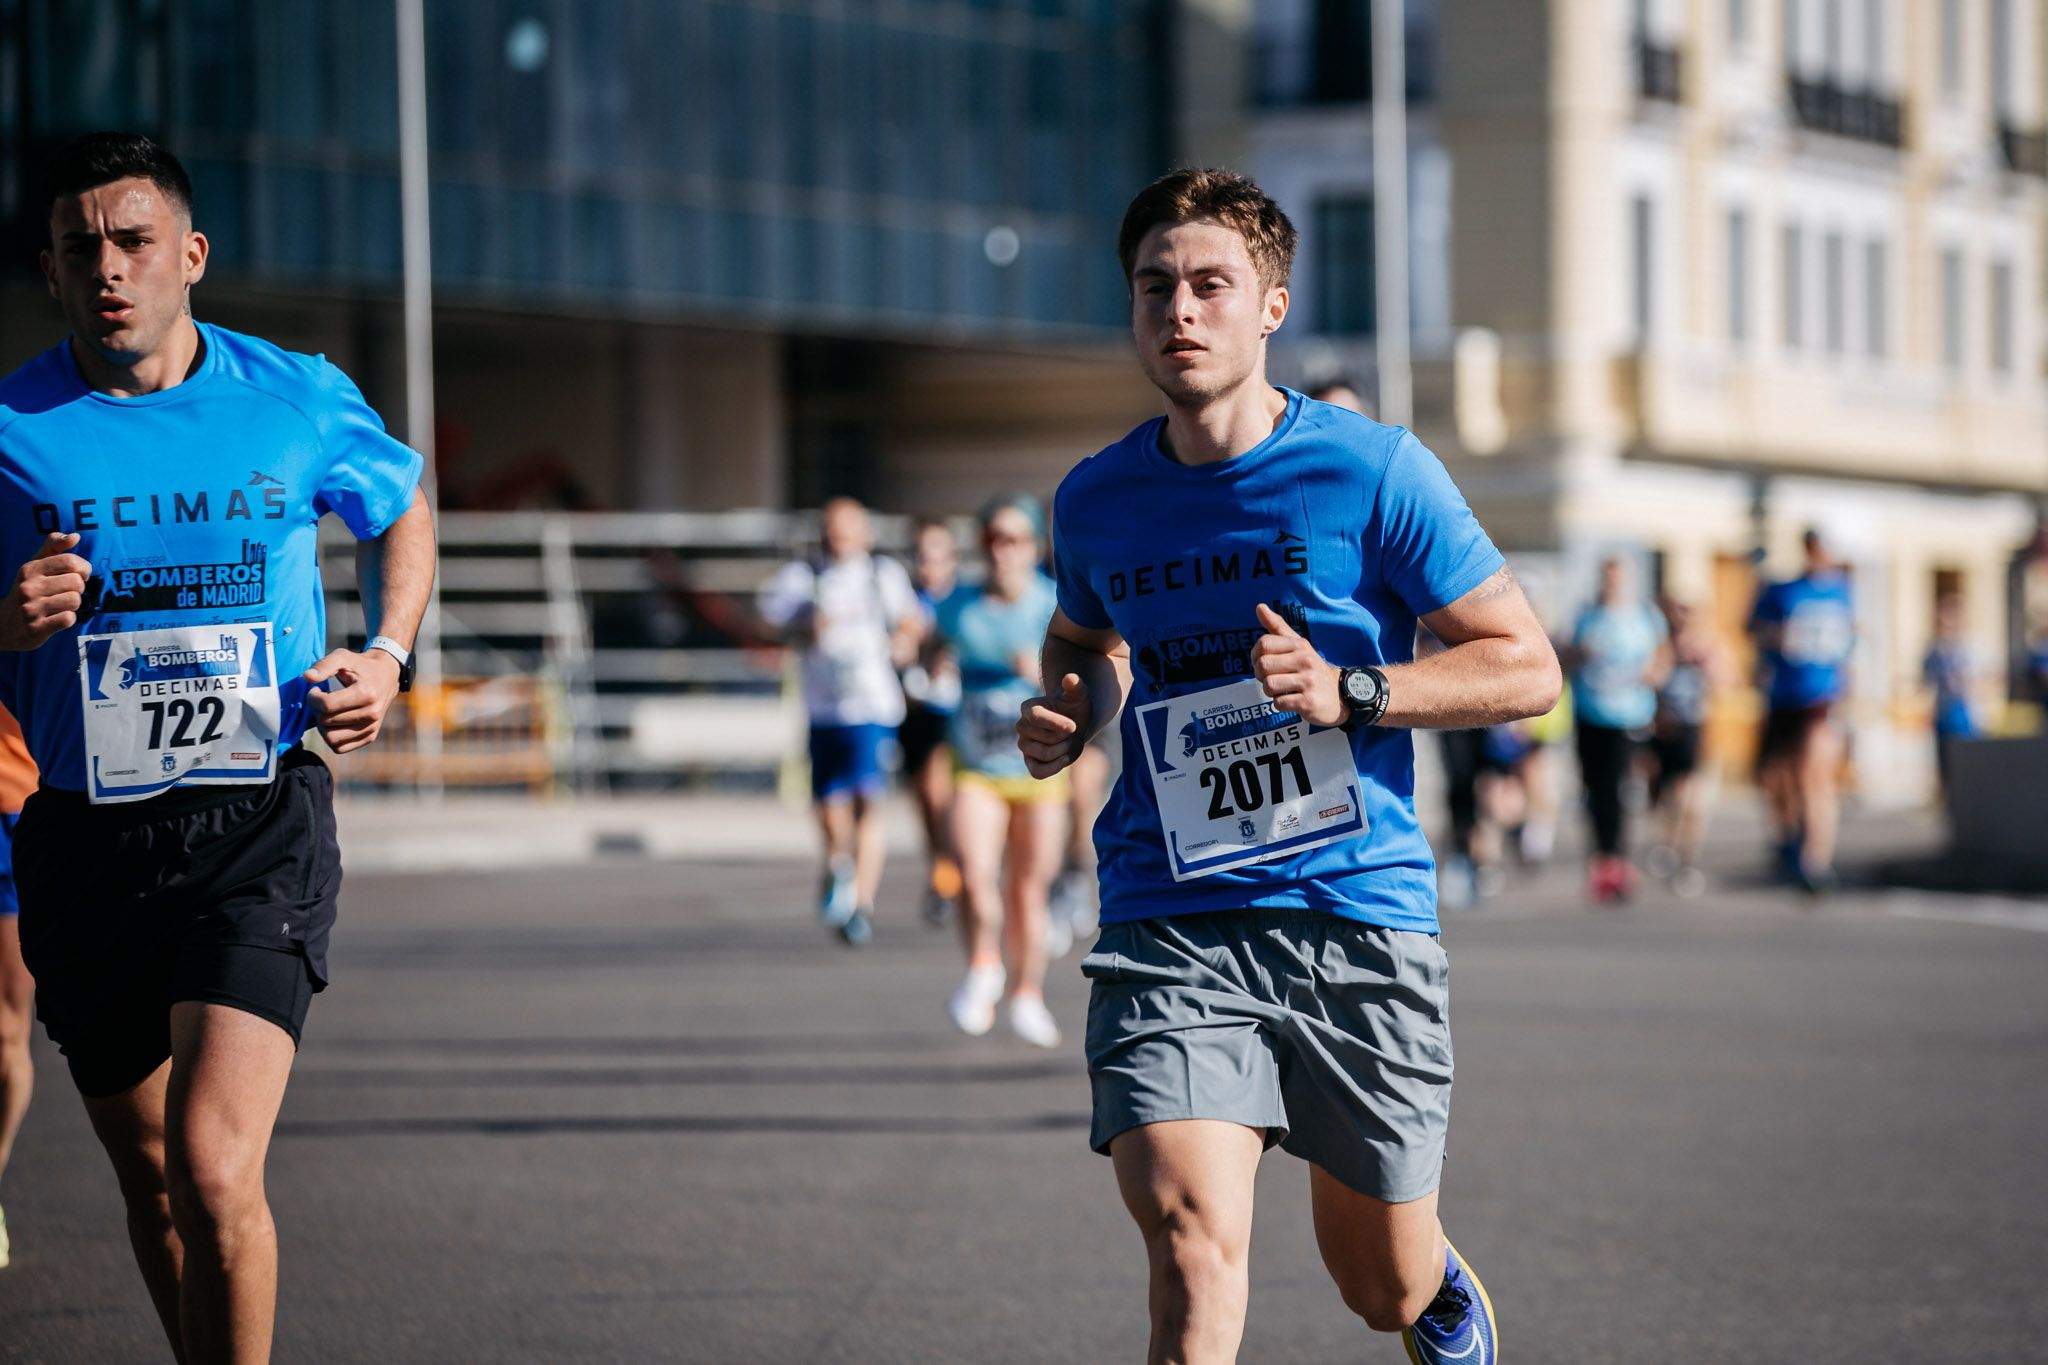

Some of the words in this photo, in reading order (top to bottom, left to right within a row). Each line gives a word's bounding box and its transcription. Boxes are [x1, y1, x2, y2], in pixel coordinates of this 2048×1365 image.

[32, 488, 286, 535] DECIMAS
[121, 563, 263, 590] BOMBEROS
[1109, 545, 1309, 602] DECIMAS
[177, 587, 197, 608] de
[202, 582, 262, 607] MADRID
[148, 645, 181, 653] CARRERA
[148, 649, 237, 668] BOMBEROS
[1168, 631, 1257, 660] BOMBE
[1223, 653, 1242, 674] de
[141, 677, 238, 697] DECIMAS
[141, 696, 225, 750] 722
[1203, 703, 1235, 716] CARRERA
[1205, 702, 1281, 731] BOMBER
[1203, 726, 1300, 763] DECIMAS
[1200, 746, 1313, 820] 2071
